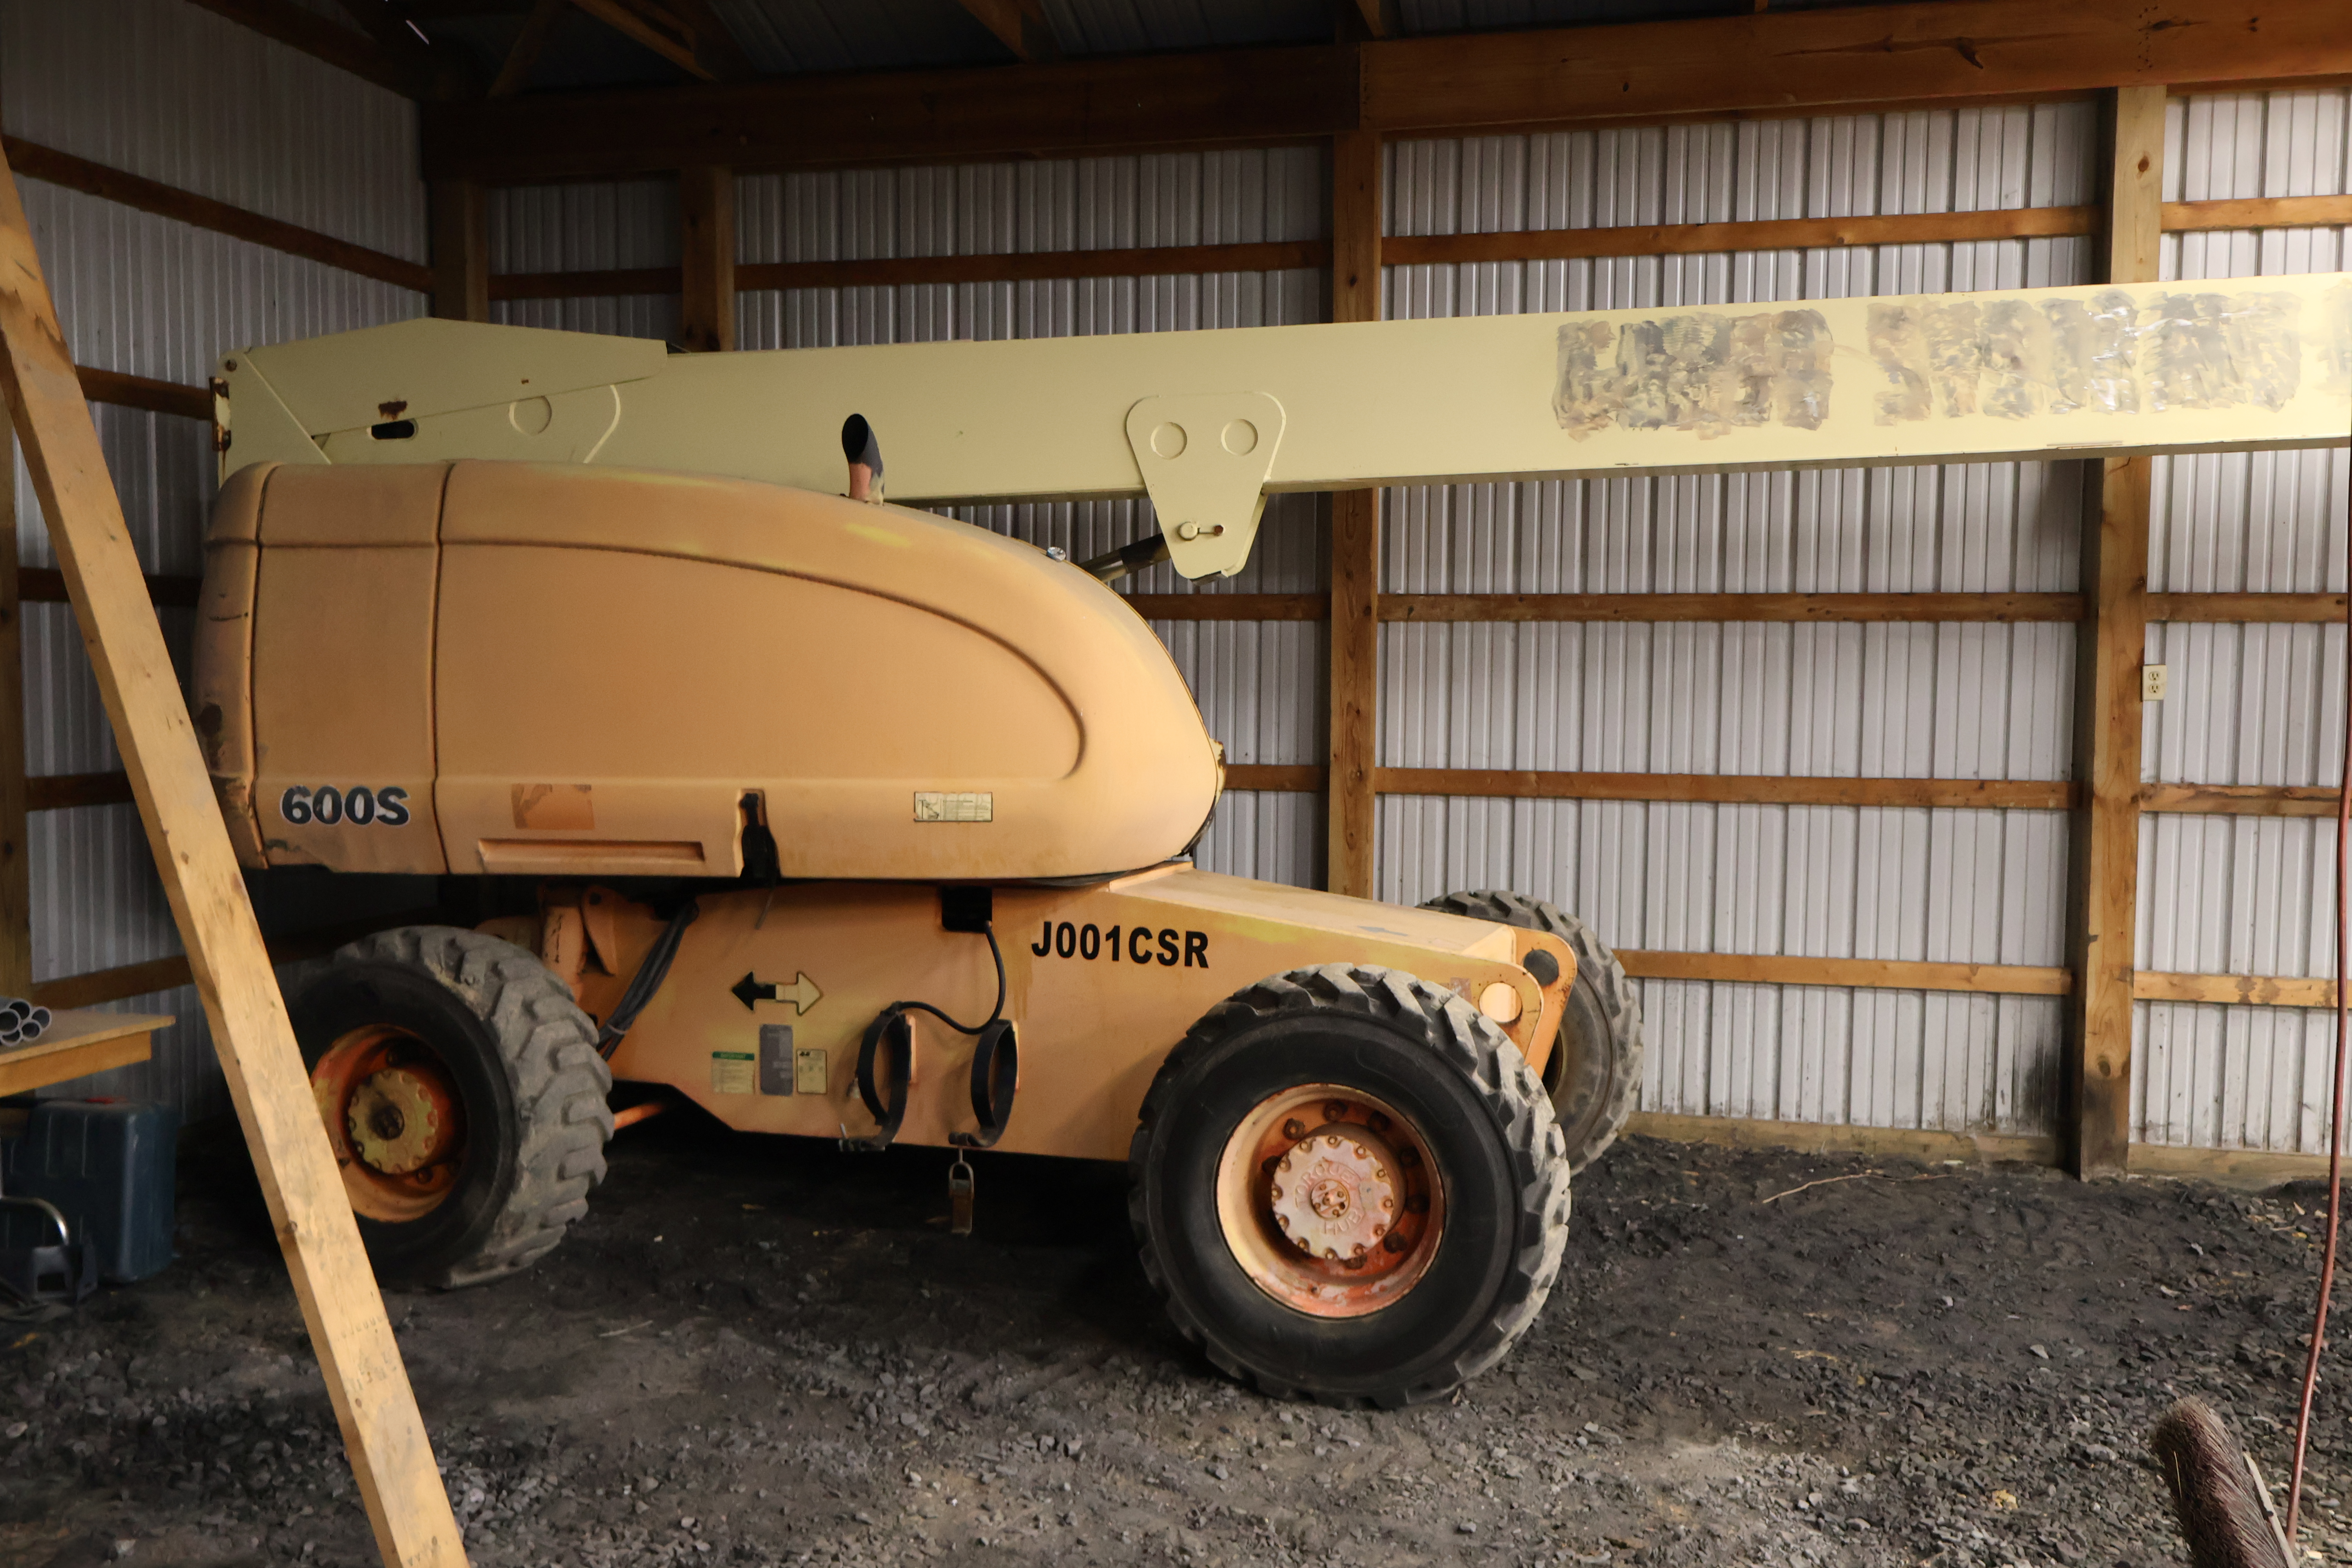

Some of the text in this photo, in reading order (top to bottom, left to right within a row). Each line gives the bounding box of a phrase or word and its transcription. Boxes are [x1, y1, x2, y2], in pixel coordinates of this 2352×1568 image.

[281, 784, 410, 825] 600S
[1032, 921, 1209, 968] J001CSR
[1295, 1160, 1358, 1208] TORQUE
[1323, 1209, 1362, 1235] HUB
